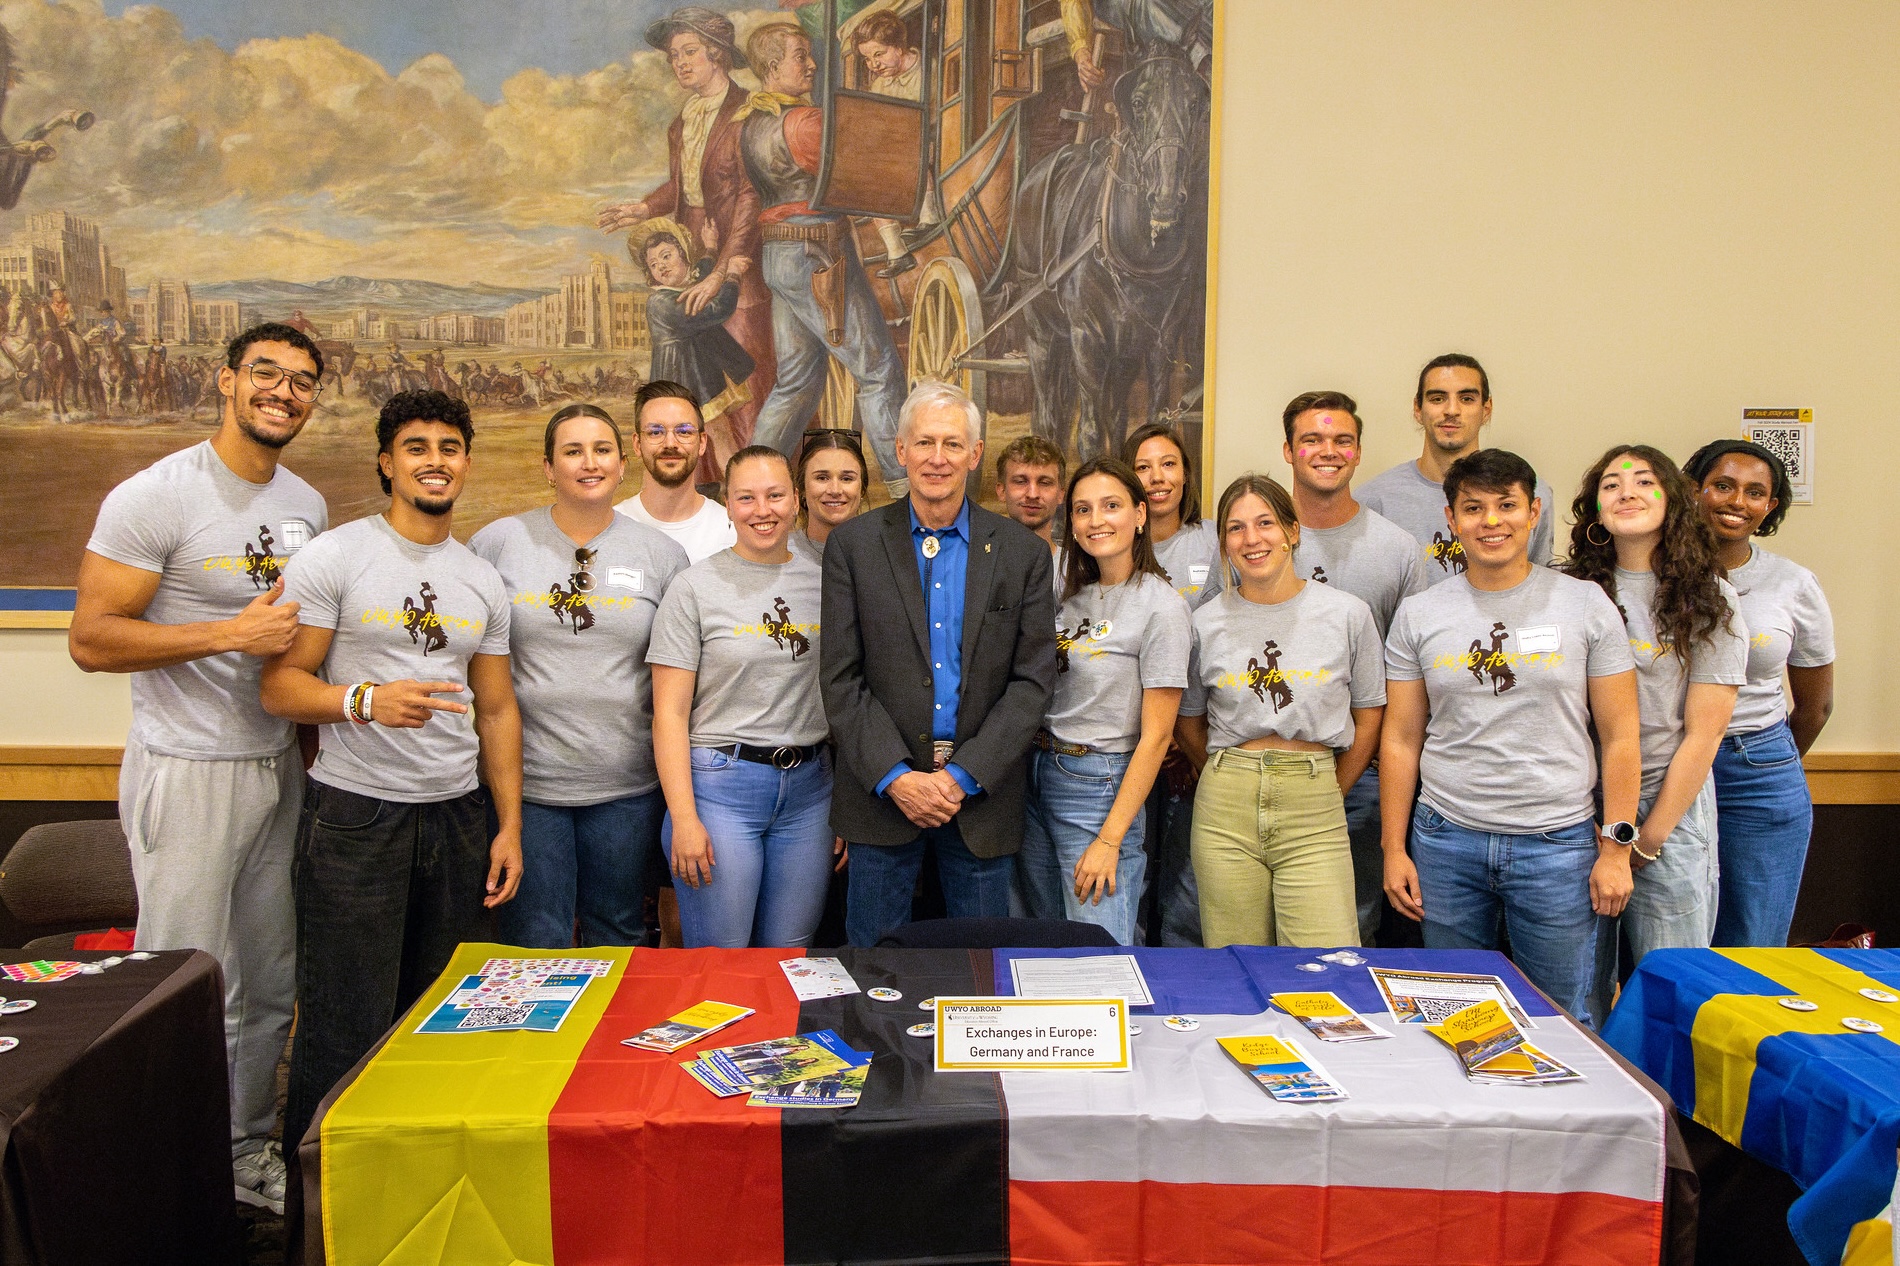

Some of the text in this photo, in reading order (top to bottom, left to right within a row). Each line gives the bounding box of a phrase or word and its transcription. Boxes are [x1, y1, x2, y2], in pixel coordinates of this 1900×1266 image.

[260, 555, 288, 575] ABR
[1109, 1007, 1116, 1018] 6
[966, 1026, 1097, 1041] Exchanges in Europe:
[970, 1046, 1095, 1060] Germany and France
